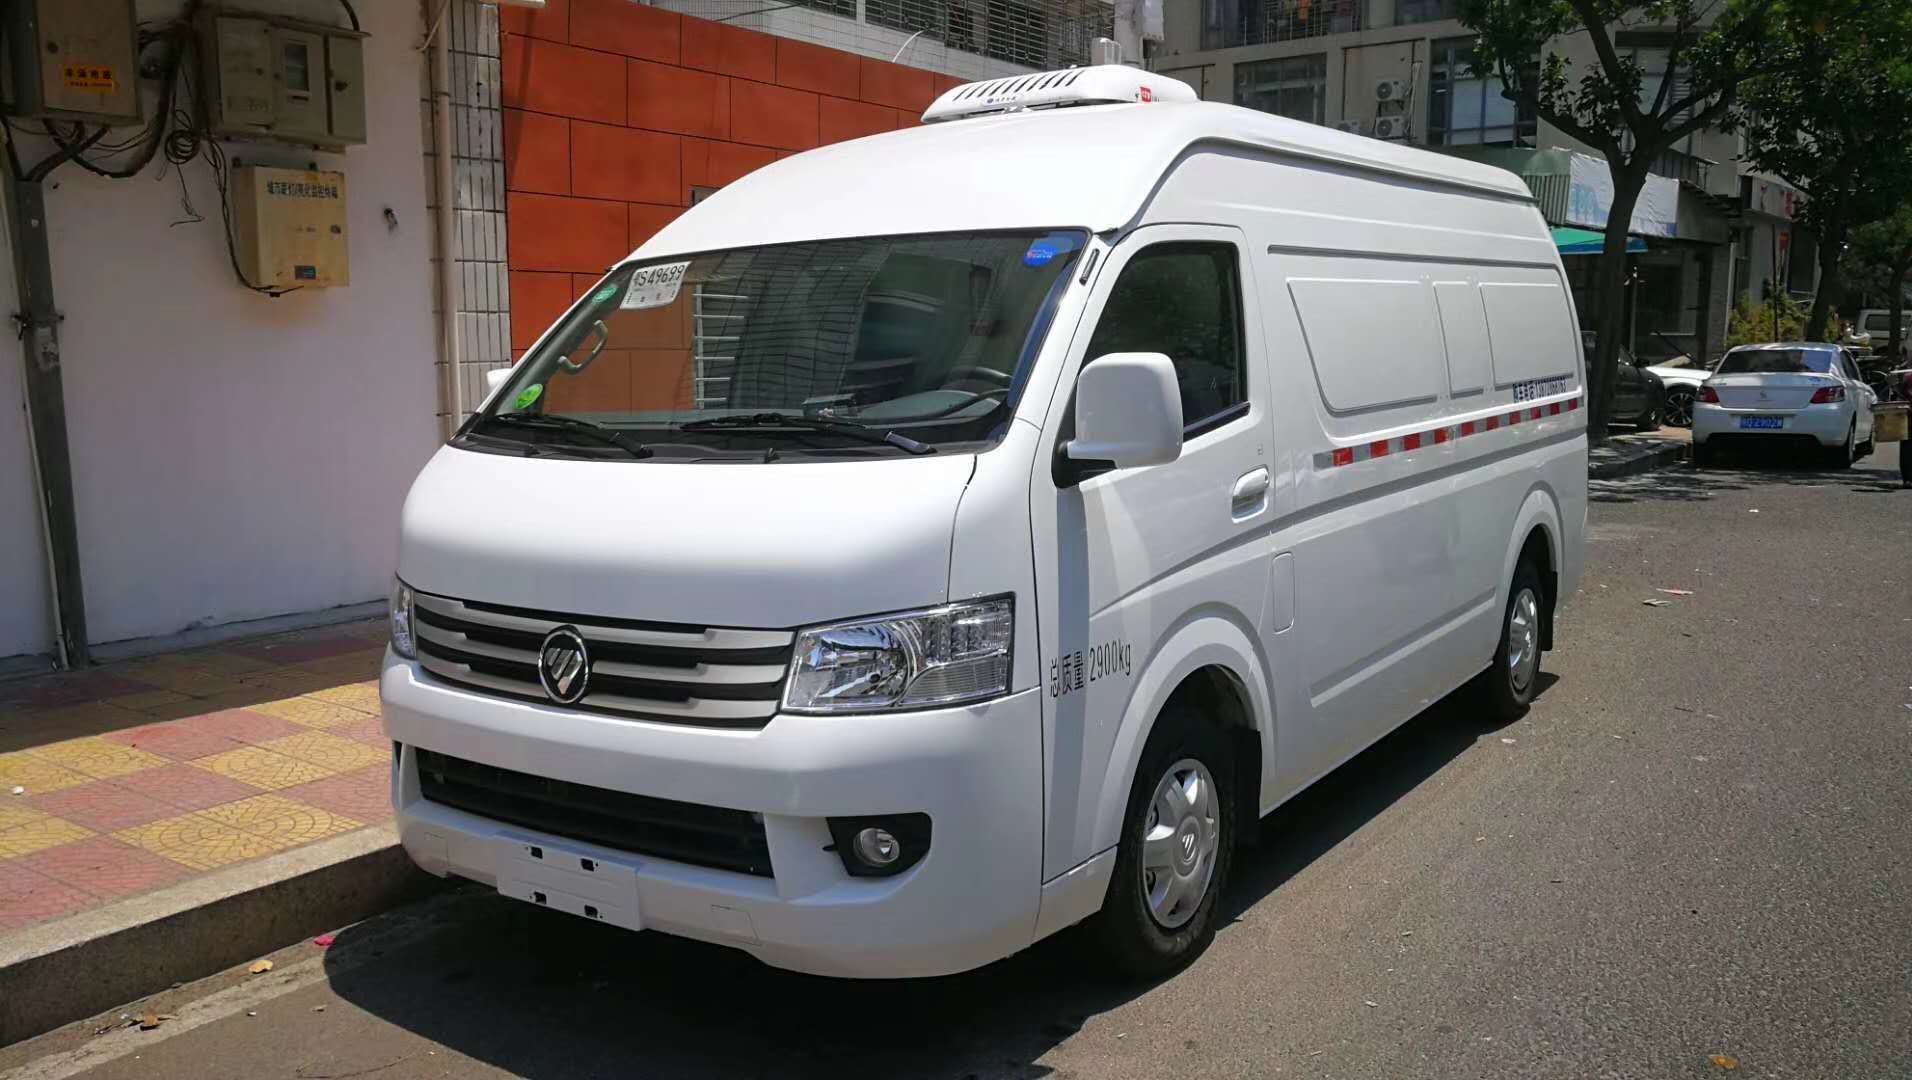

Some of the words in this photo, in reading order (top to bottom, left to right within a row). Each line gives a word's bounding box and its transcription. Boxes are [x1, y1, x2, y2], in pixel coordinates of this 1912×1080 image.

[1050, 651, 1084, 698] 总质量
[1089, 639, 1131, 682] 2900kg
